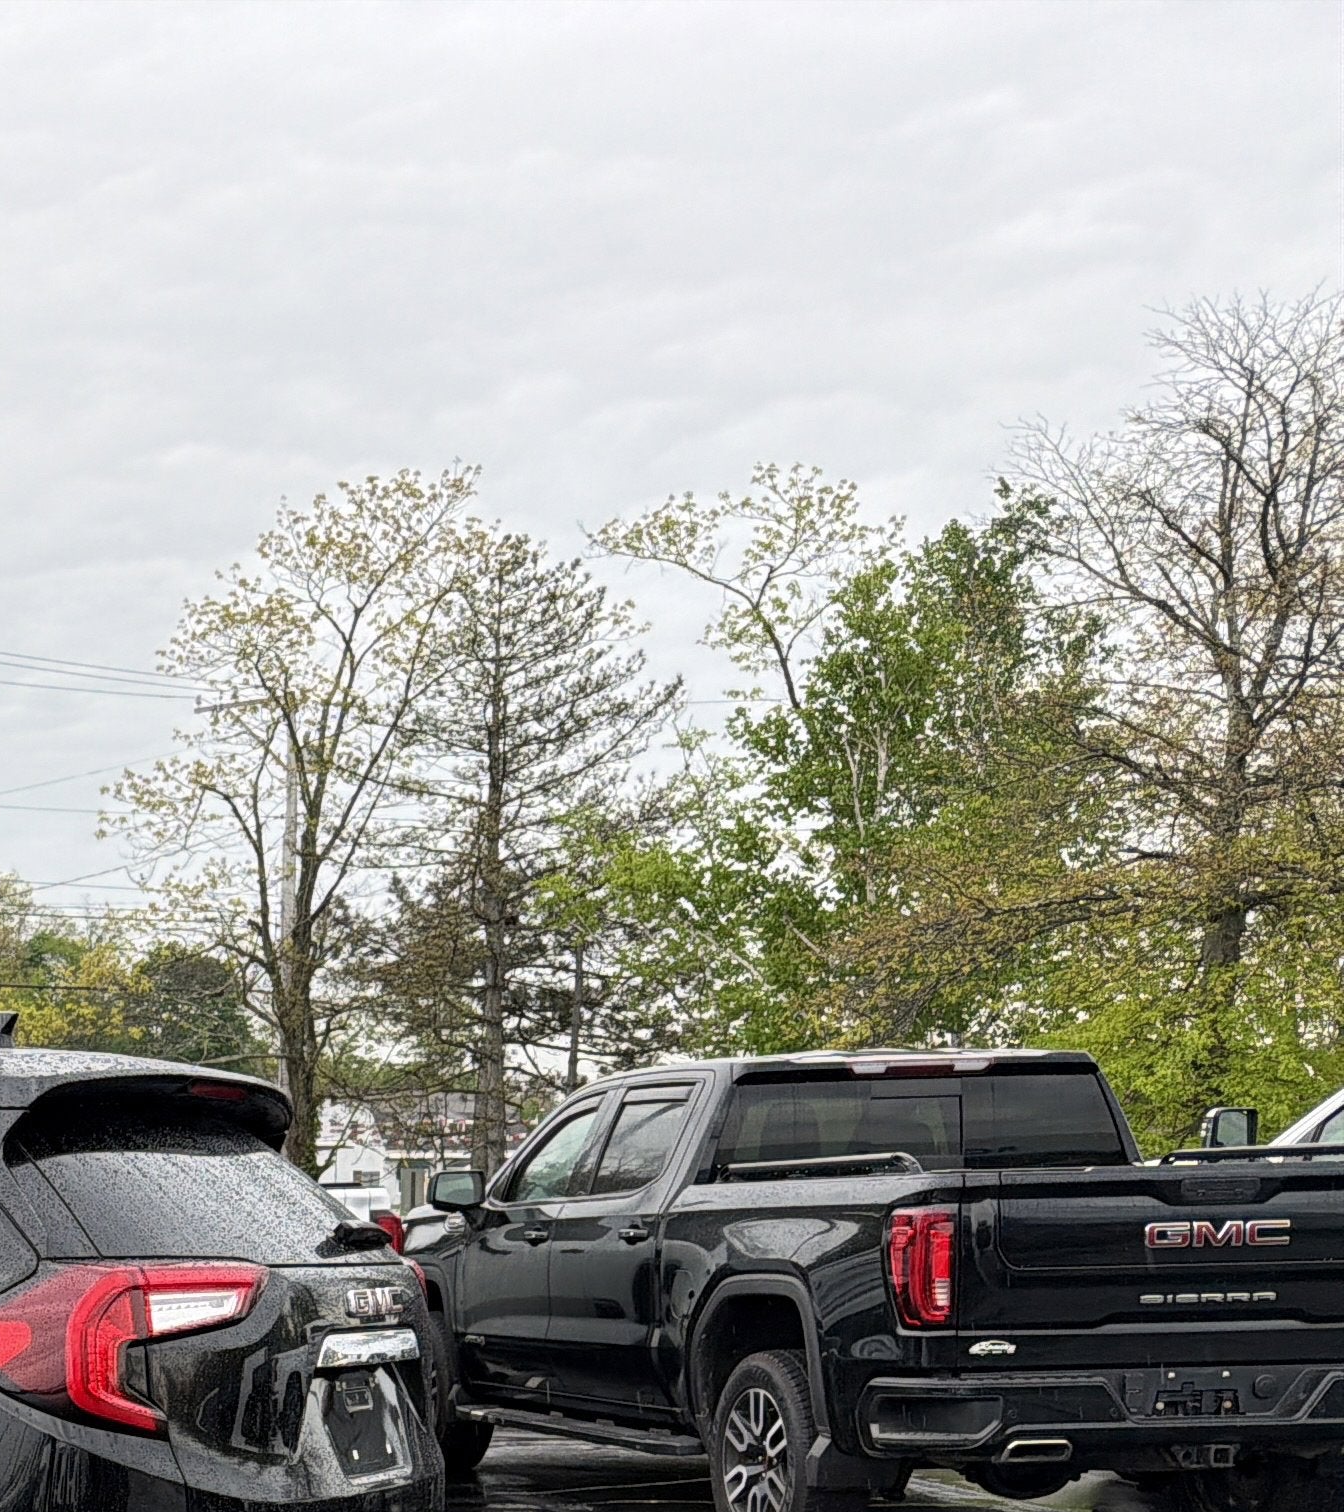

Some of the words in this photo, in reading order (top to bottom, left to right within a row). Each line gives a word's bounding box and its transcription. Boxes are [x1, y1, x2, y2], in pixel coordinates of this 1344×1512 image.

[1144, 1219, 1291, 1249] GMC
[346, 1286, 405, 1316] GMC
[1139, 1291, 1277, 1304] SIERRA
